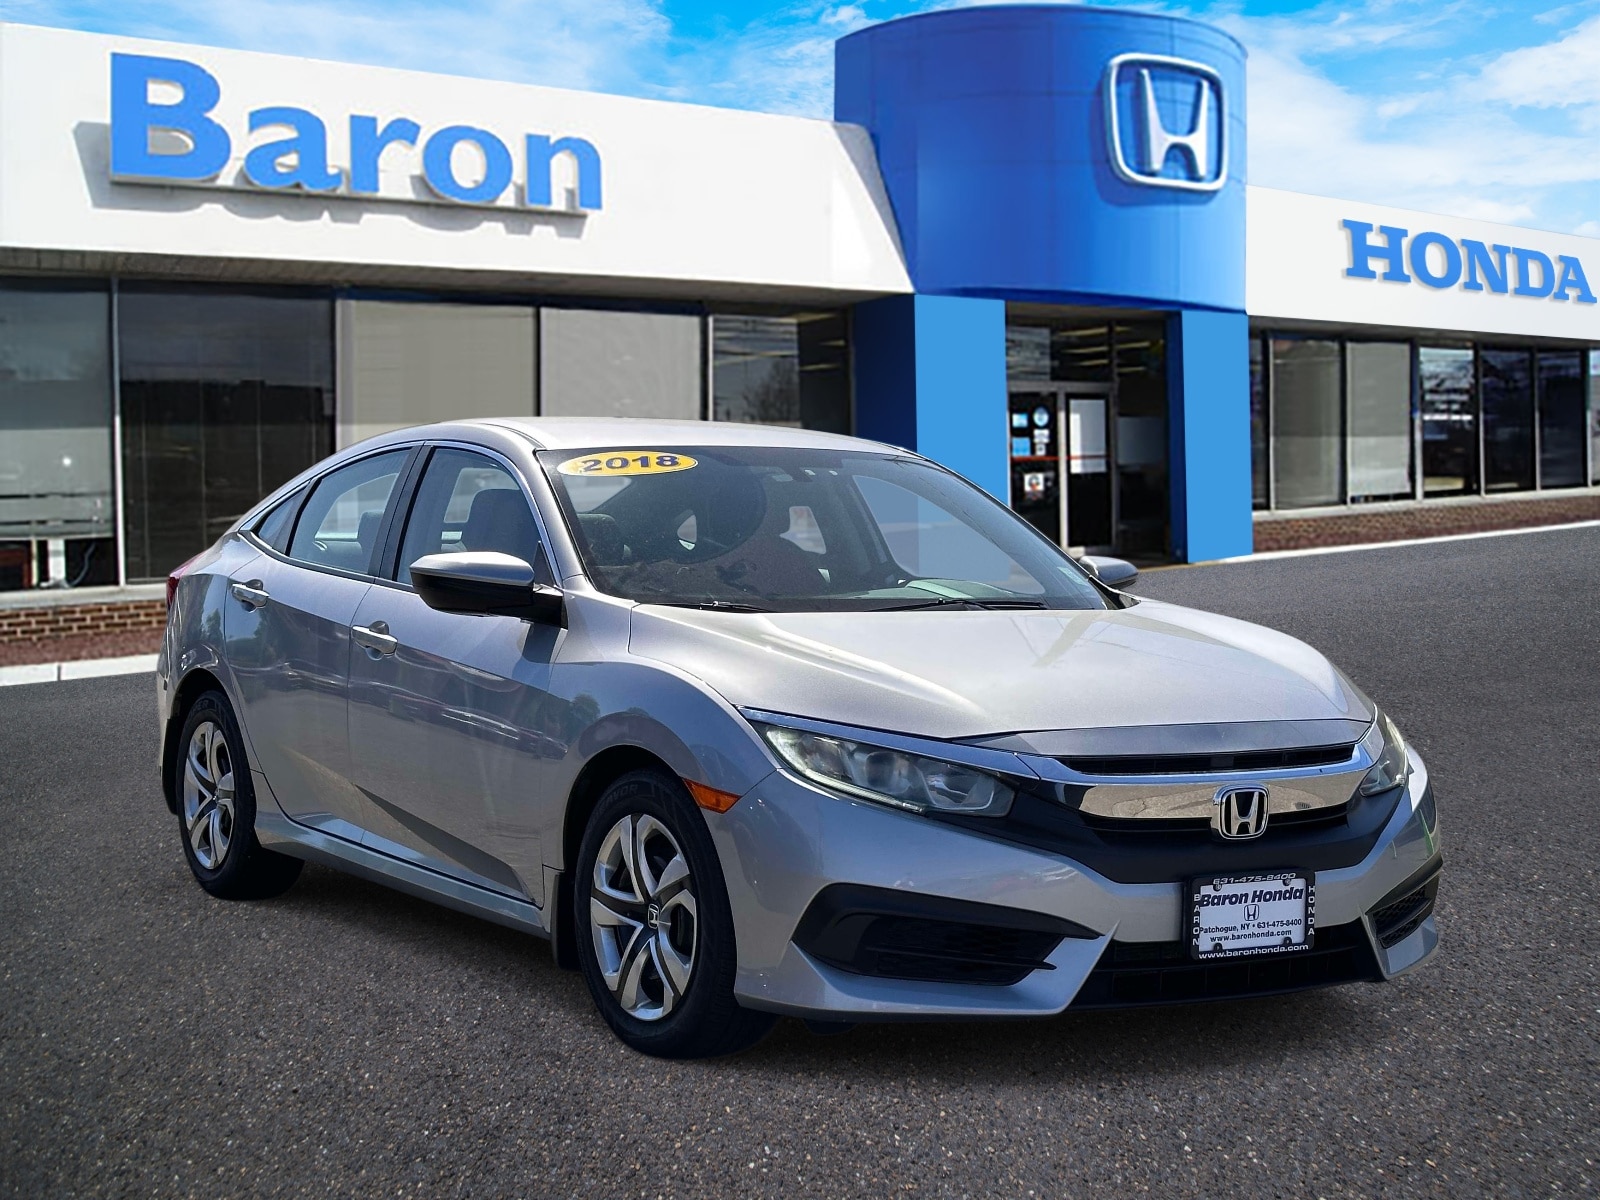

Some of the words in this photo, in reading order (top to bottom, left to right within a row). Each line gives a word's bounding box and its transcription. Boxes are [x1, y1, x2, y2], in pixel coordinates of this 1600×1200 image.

[110, 51, 603, 211] Baron
[1342, 218, 1598, 304] HONDA
[581, 455, 680, 472] 2018
[1213, 872, 1297, 885] 631-475-8400
[1200, 892, 1249, 908] Baron
[1250, 887, 1304, 903] Honda
[1193, 894, 1201, 946] BARON
[1308, 885, 1316, 936] HONDA
[1240, 923, 1251, 931] NY
[1256, 918, 1302, 929] 631-475-8400
[1210, 929, 1292, 942] www.baronhonda.com
[1198, 944, 1309, 959] www.baronhonda.com
